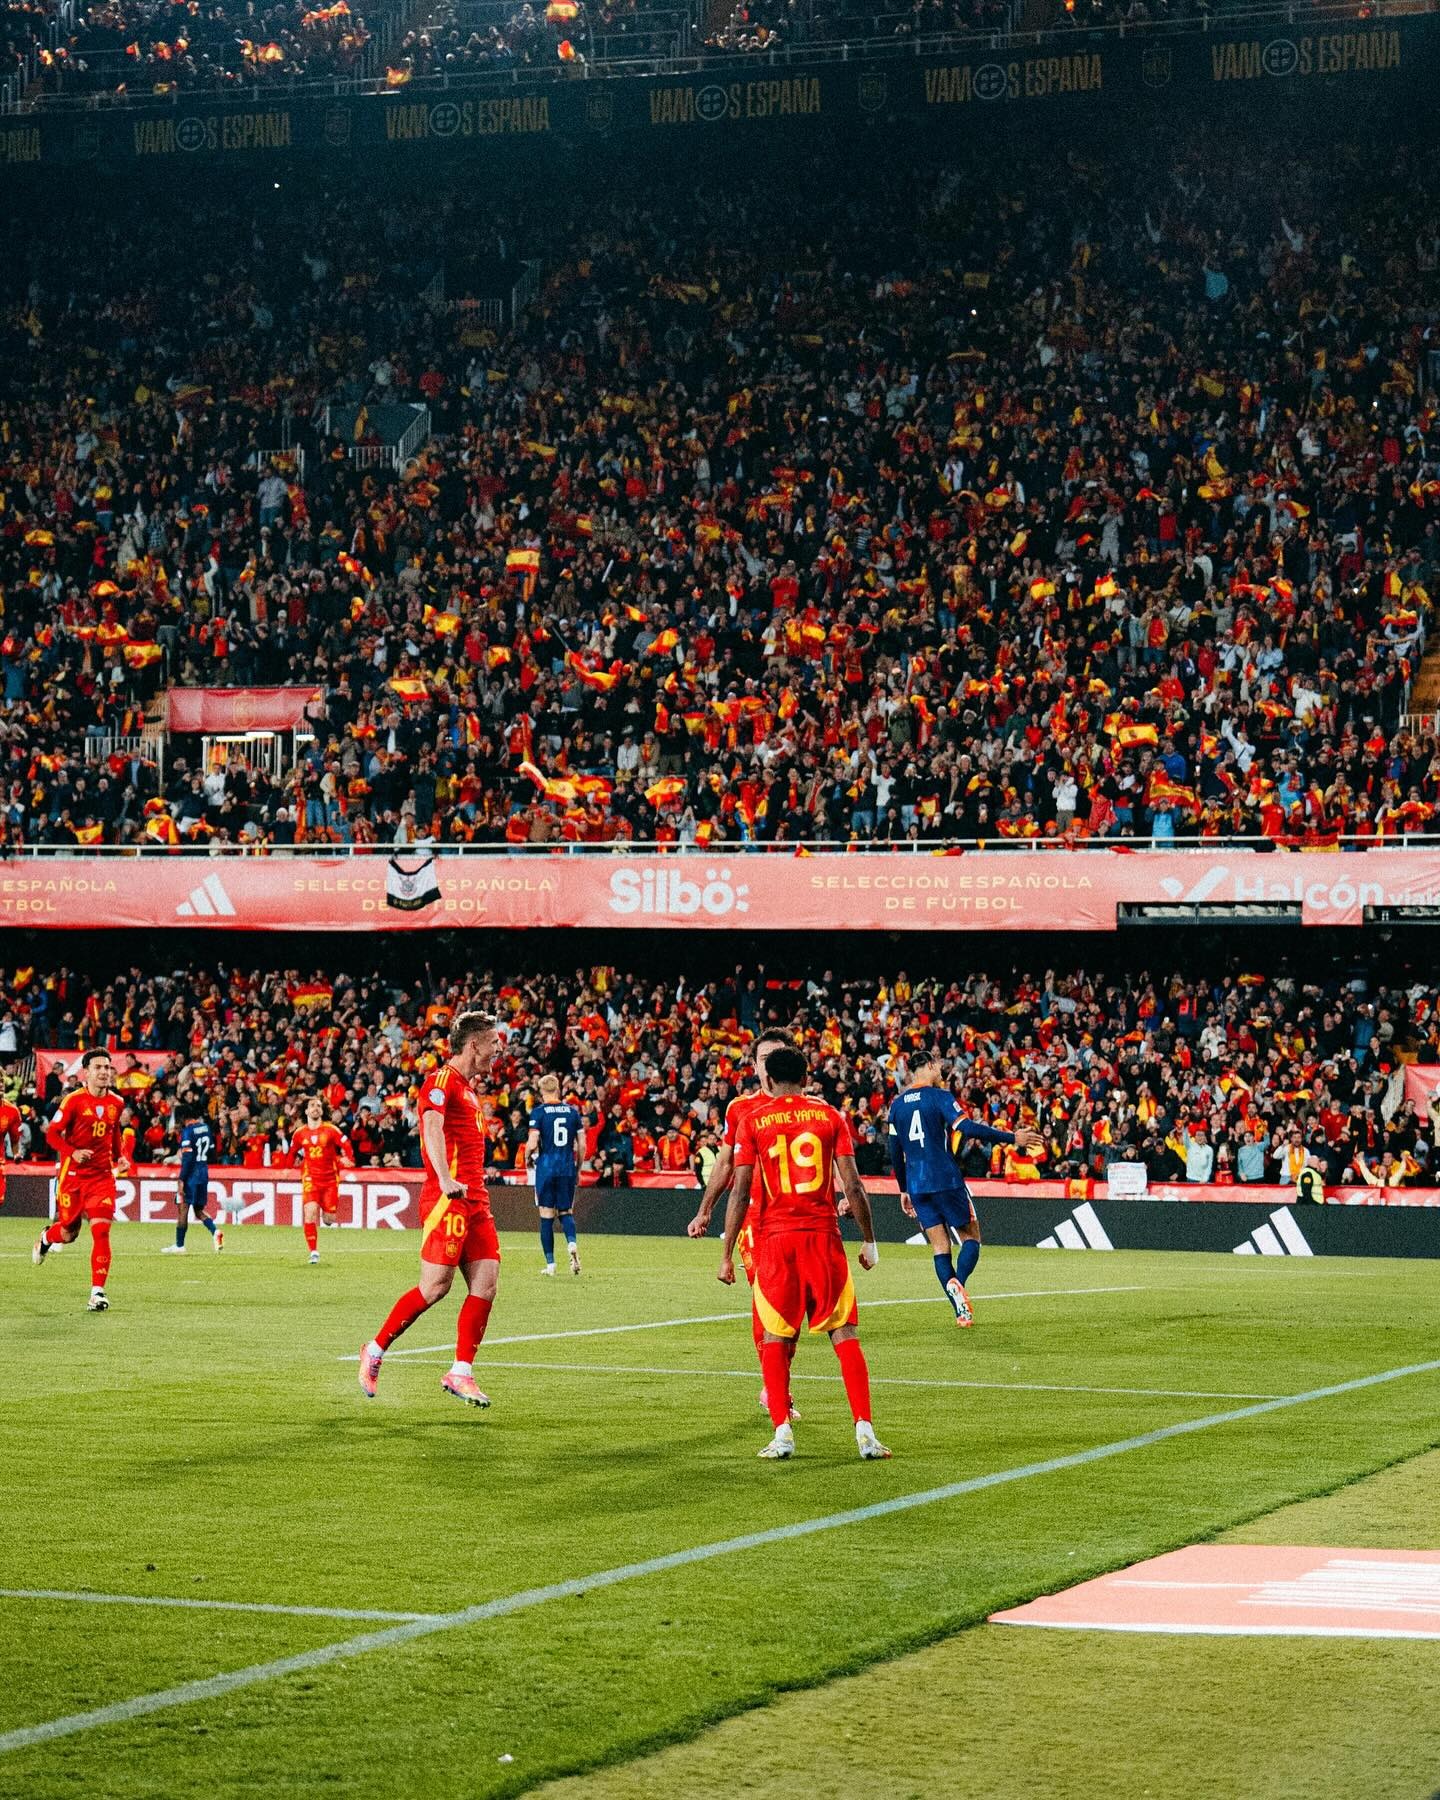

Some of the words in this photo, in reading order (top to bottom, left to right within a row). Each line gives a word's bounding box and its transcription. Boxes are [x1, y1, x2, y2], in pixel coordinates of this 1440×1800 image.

[1316, 25, 1400, 74] ESPAÑA
[1025, 49, 1102, 97] ESPAÑA
[746, 73, 820, 117] ESPAÑA
[478, 92, 549, 134] ESPAÑA
[3, 876, 116, 892] ESPAÑOLA
[294, 879, 388, 892] SELECCI
[438, 876, 553, 892] SPAÑOLA
[811, 872, 949, 889] SELECCIÓN
[959, 873, 1092, 889] ESPAÑOLA
[1235, 873, 1385, 909] Halcón
[884, 897, 916, 910] DE
[926, 893, 1023, 910] FÚTBOL
[91, 1120, 107, 1137] 18
[553, 1117, 568, 1147] 6
[755, 1111, 793, 1129] LAMINE
[794, 1109, 830, 1122] YAMAL
[908, 1110, 925, 1148] 4
[195, 1135, 210, 1161] 12
[309, 1146, 323, 1158] 22
[768, 1131, 824, 1194] 19
[443, 1212, 465, 1237] 10
